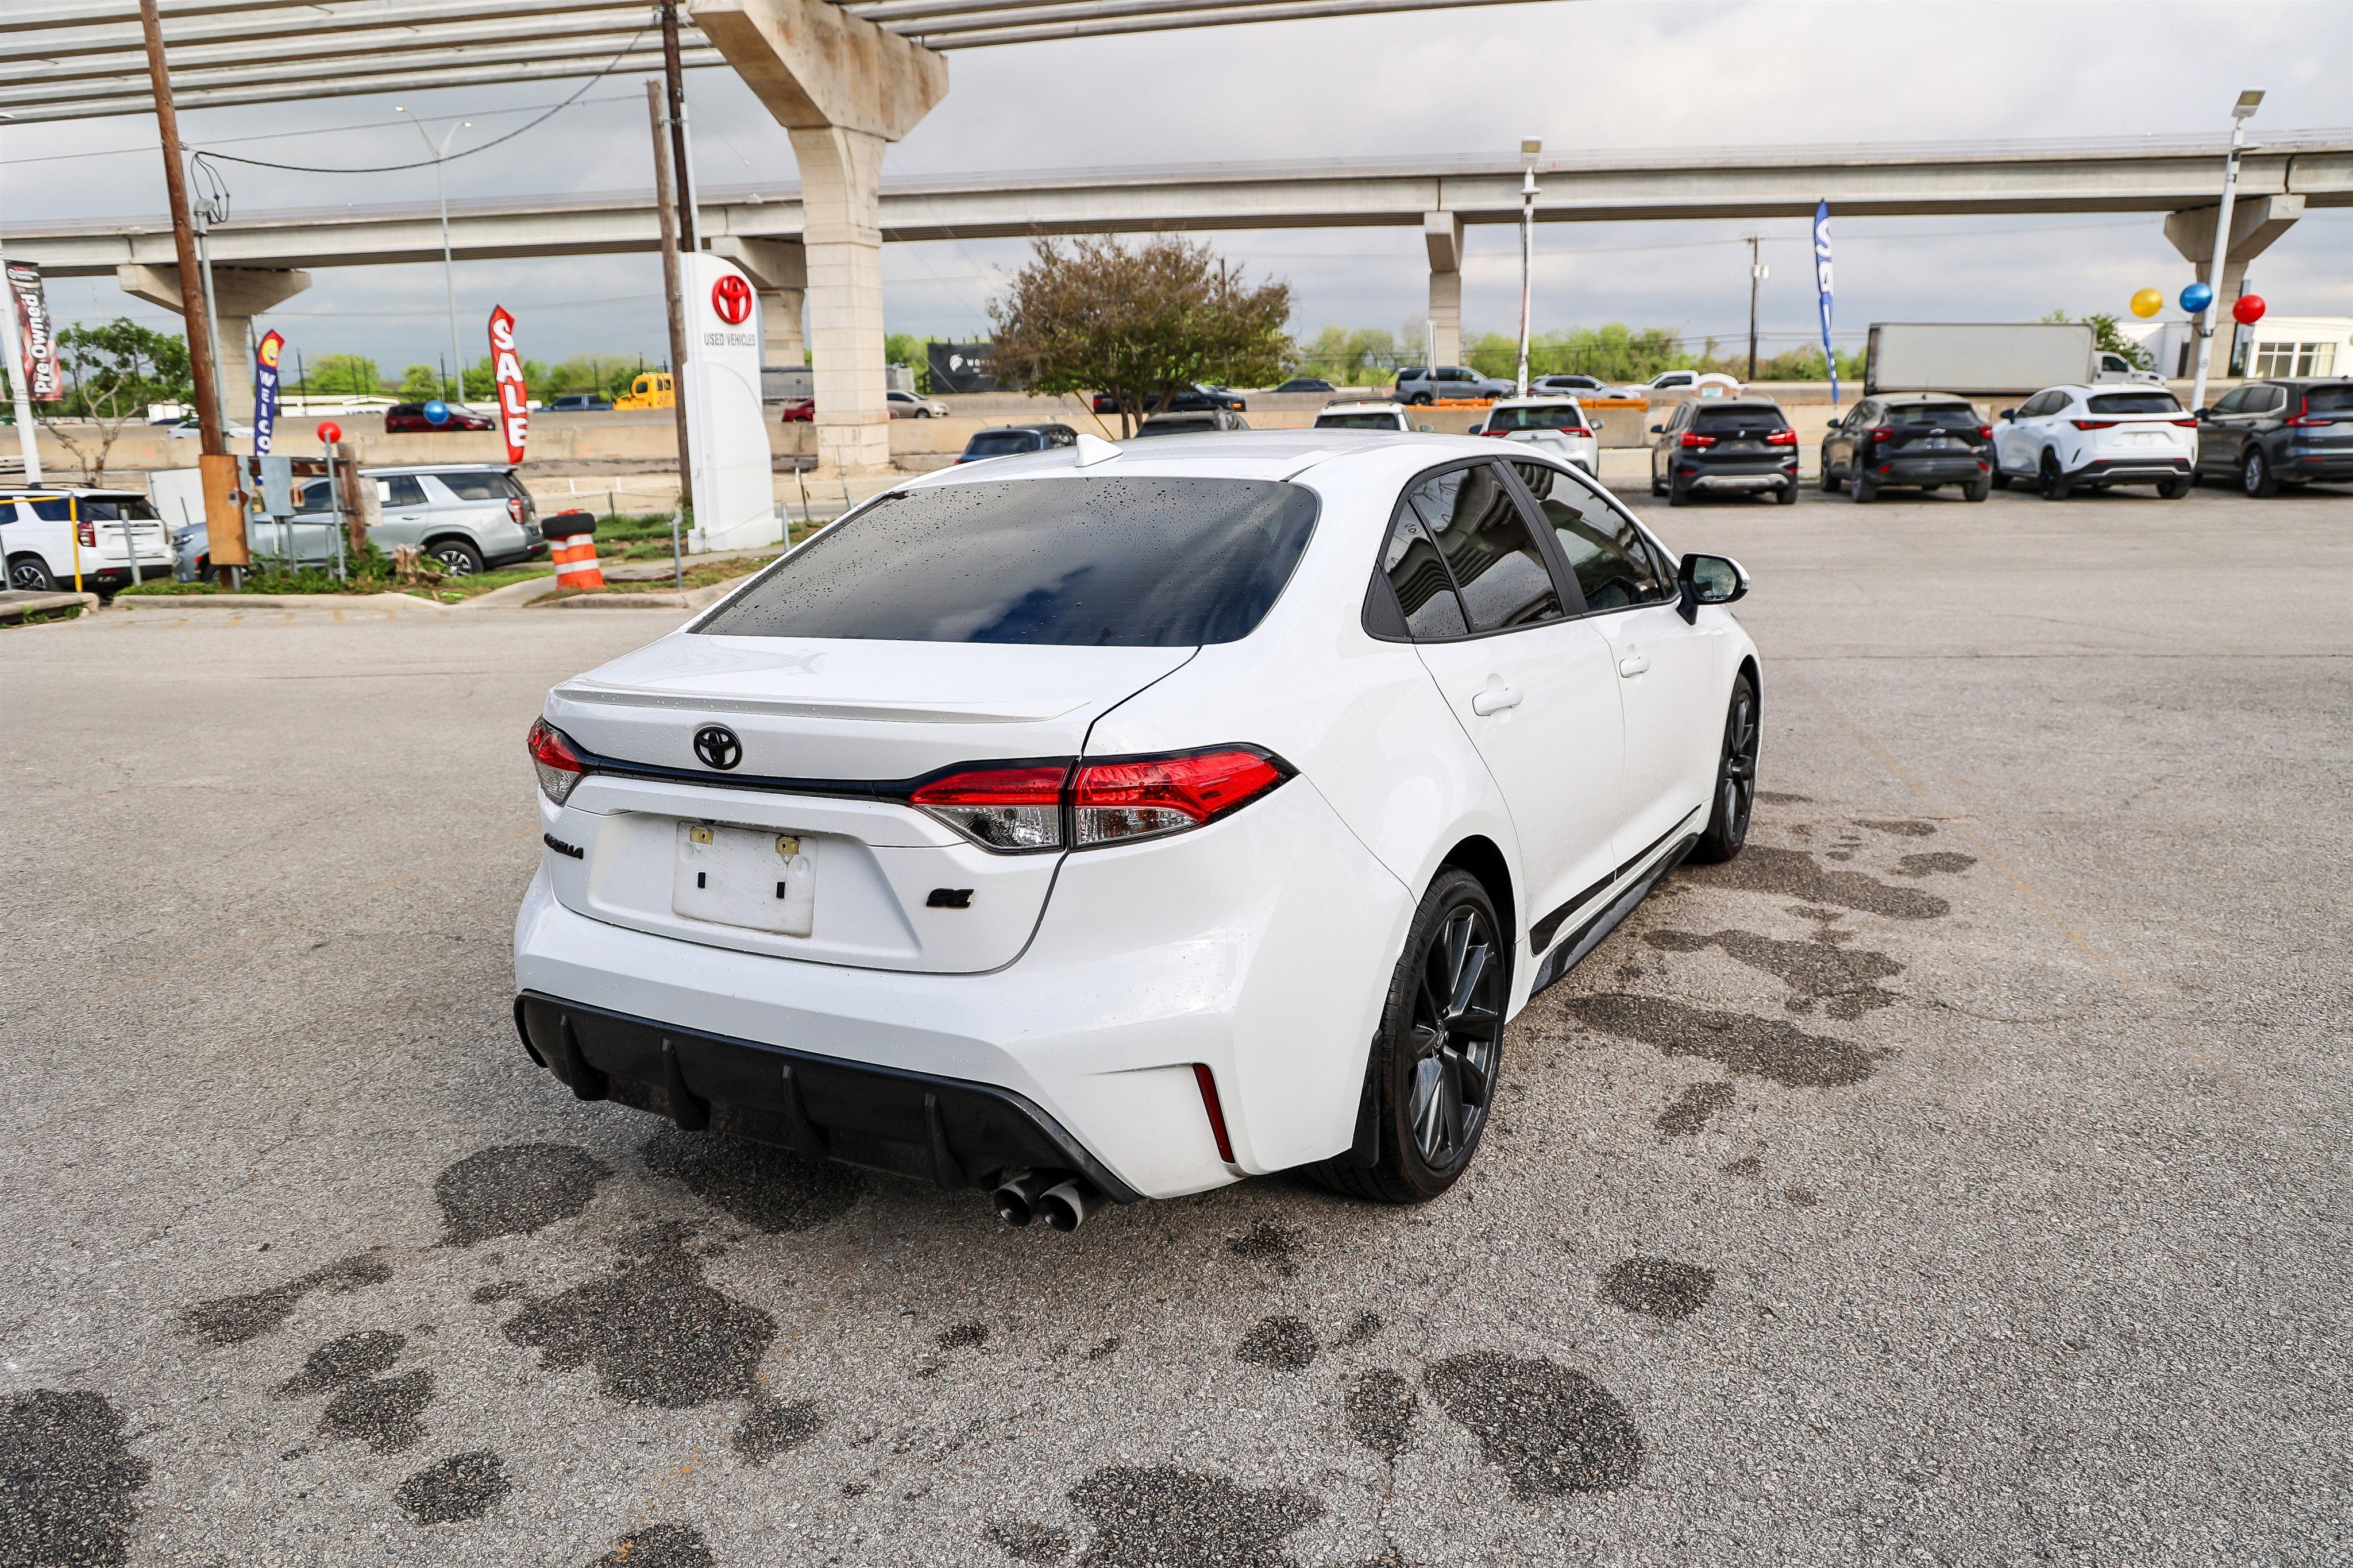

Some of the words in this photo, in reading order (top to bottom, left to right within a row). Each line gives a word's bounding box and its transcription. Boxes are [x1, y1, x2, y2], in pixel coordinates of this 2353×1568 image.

[20, 293, 49, 360] Owned
[704, 332, 724, 345] USED
[726, 333, 755, 346] VEHICLES
[34, 361, 51, 395] Pre
[493, 318, 529, 447] SALE
[925, 887, 974, 909] SE
